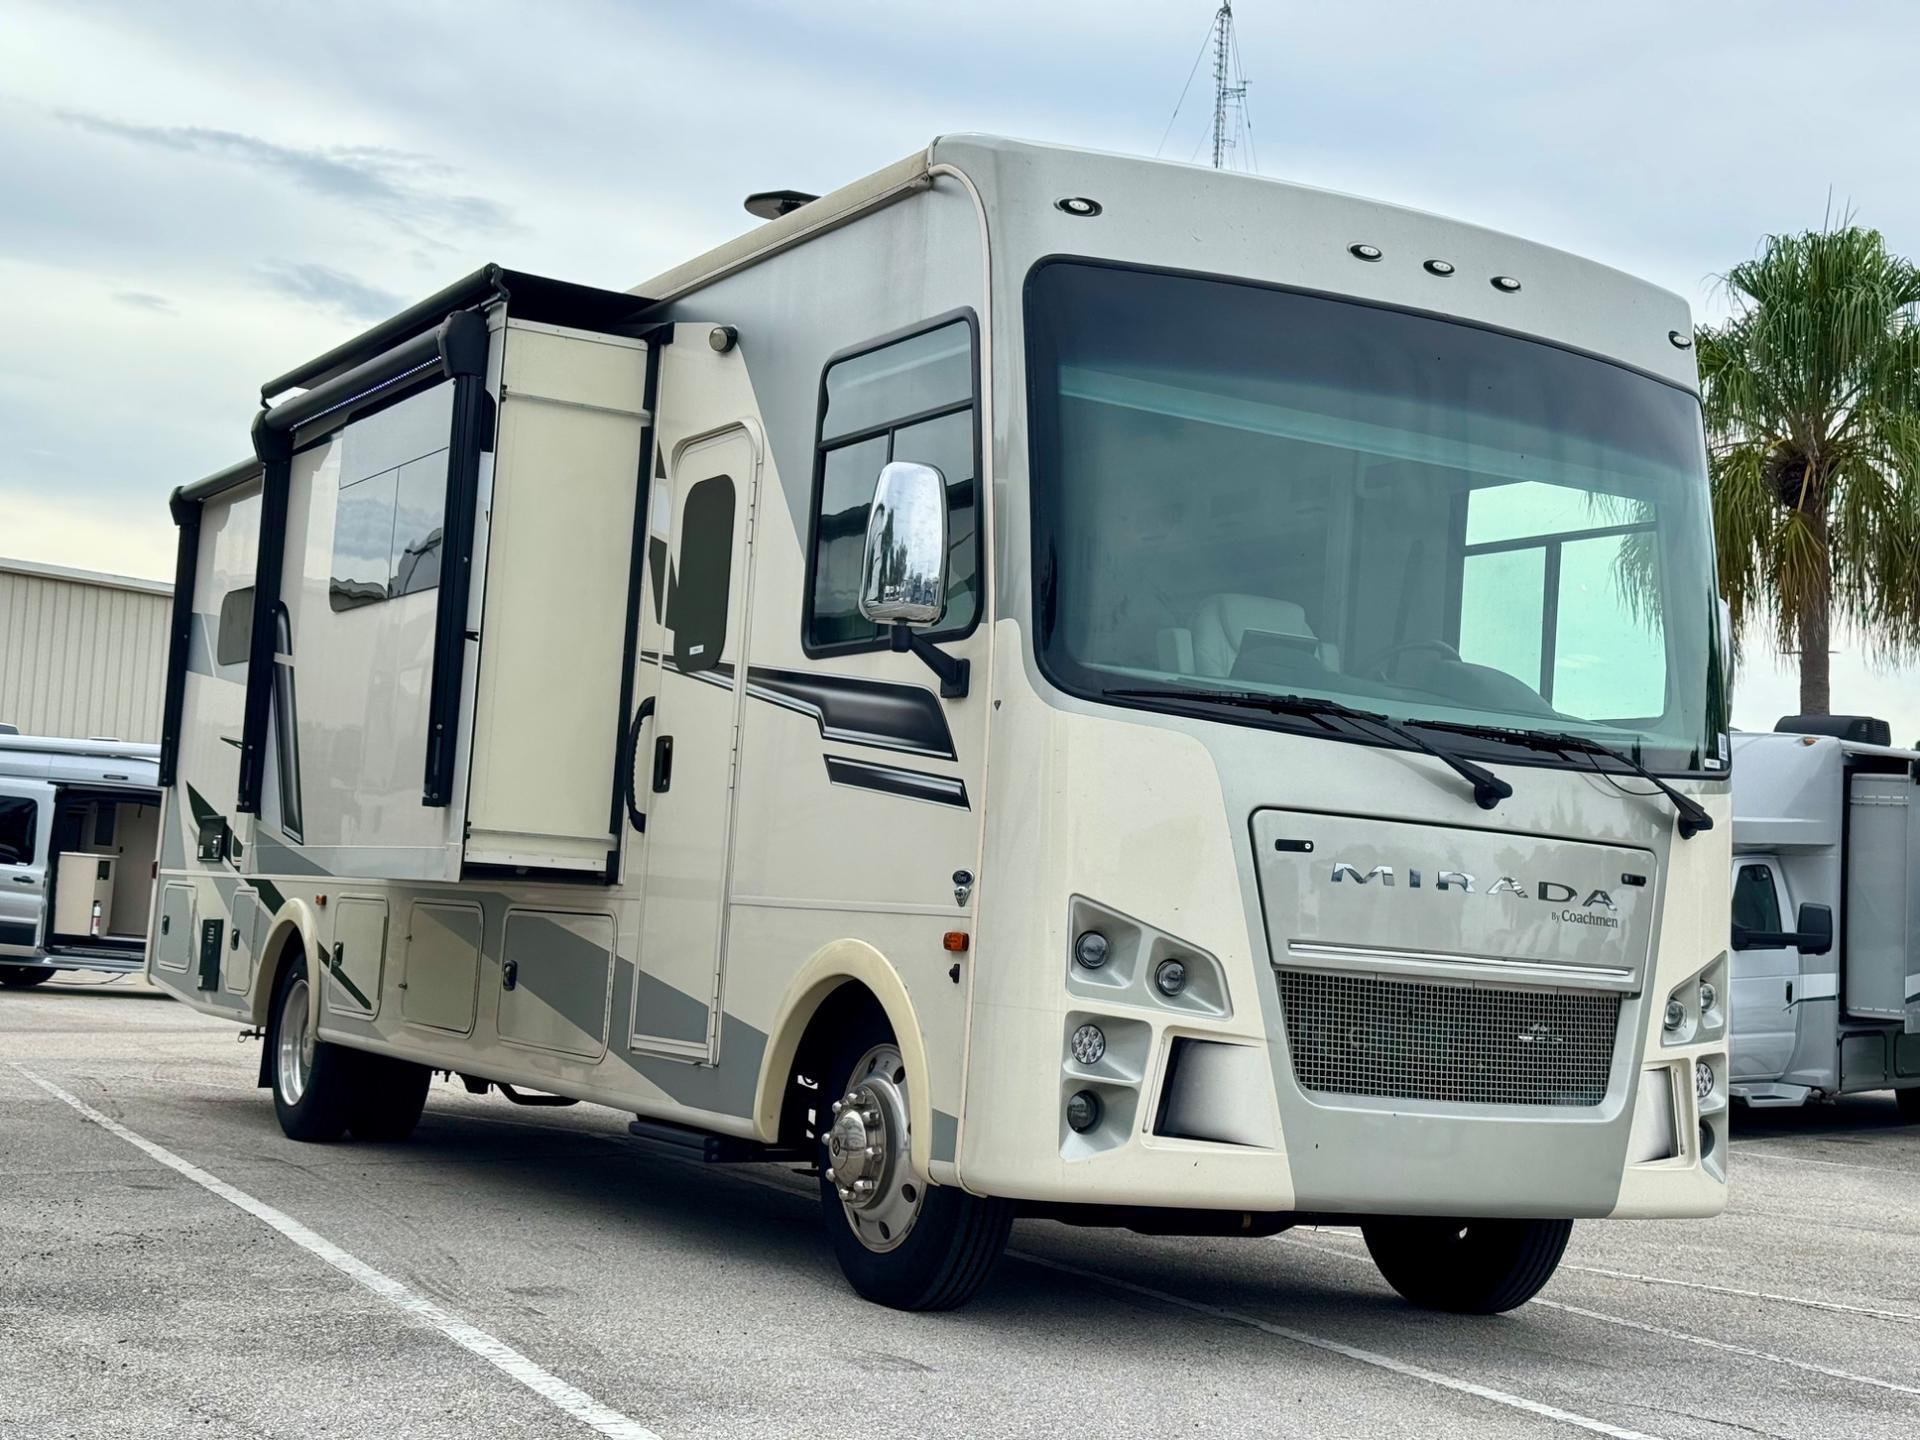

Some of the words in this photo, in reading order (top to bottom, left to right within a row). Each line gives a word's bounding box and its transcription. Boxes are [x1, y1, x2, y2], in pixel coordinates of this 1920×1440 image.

[1331, 862, 1618, 911] MIRADA
[1551, 912, 1560, 923] By
[1561, 909, 1618, 928] Coachmen
